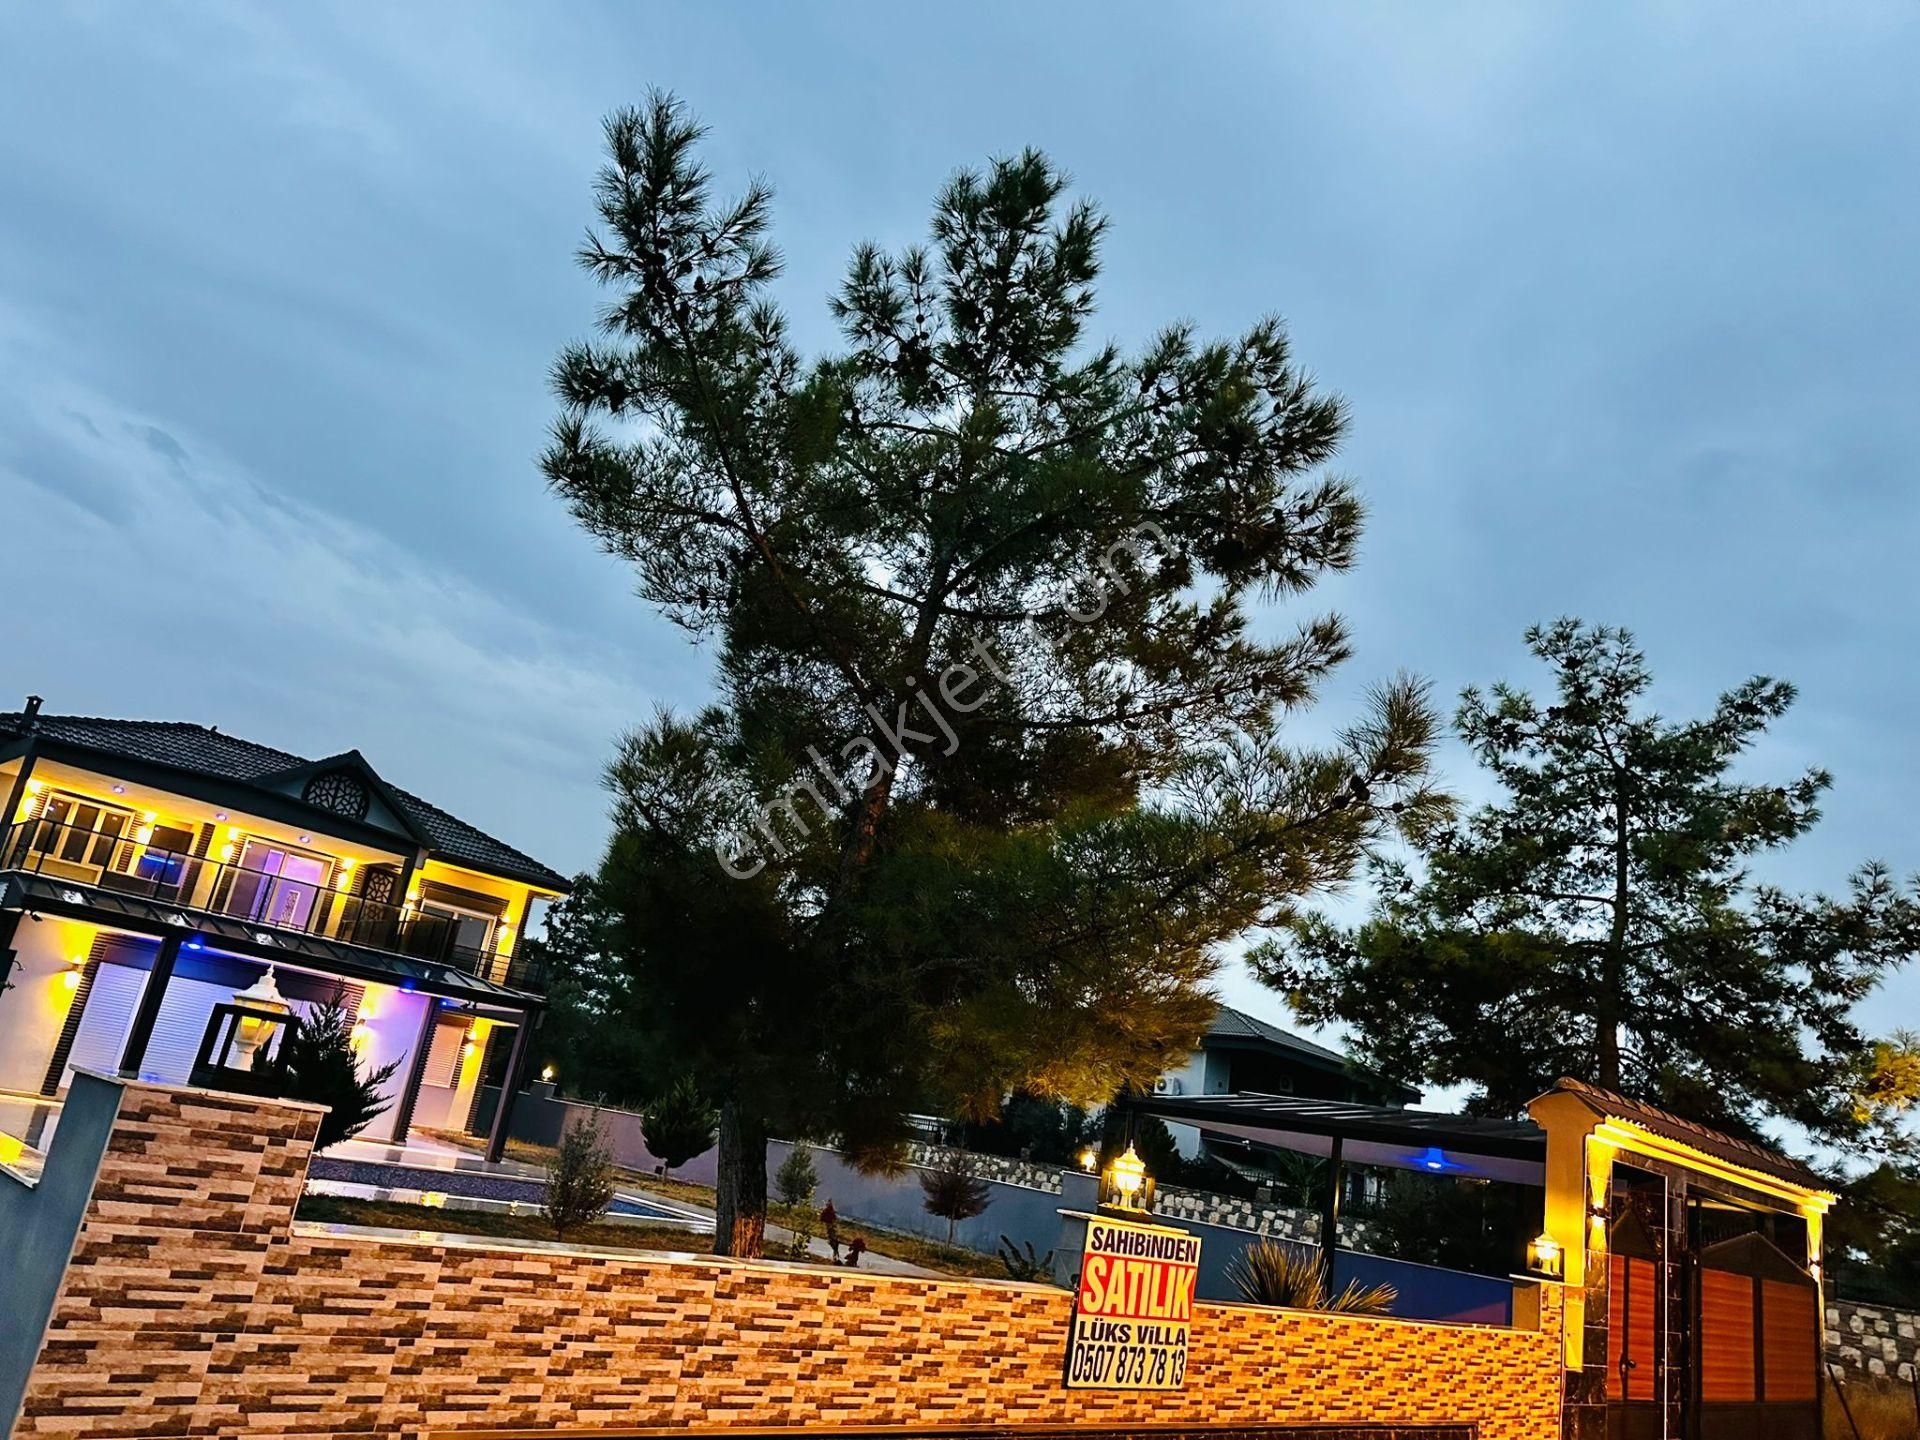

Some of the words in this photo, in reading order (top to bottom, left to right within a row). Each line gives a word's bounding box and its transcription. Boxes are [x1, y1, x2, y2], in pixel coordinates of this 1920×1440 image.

[1082, 1256, 1196, 1319] SATILIK
[1078, 1317, 1132, 1343] LÜKS
[1072, 1342, 1115, 1383] 0507
[1115, 1345, 1146, 1384] 873
[1147, 1347, 1168, 1385] 78
[1170, 1349, 1185, 1386] 13
